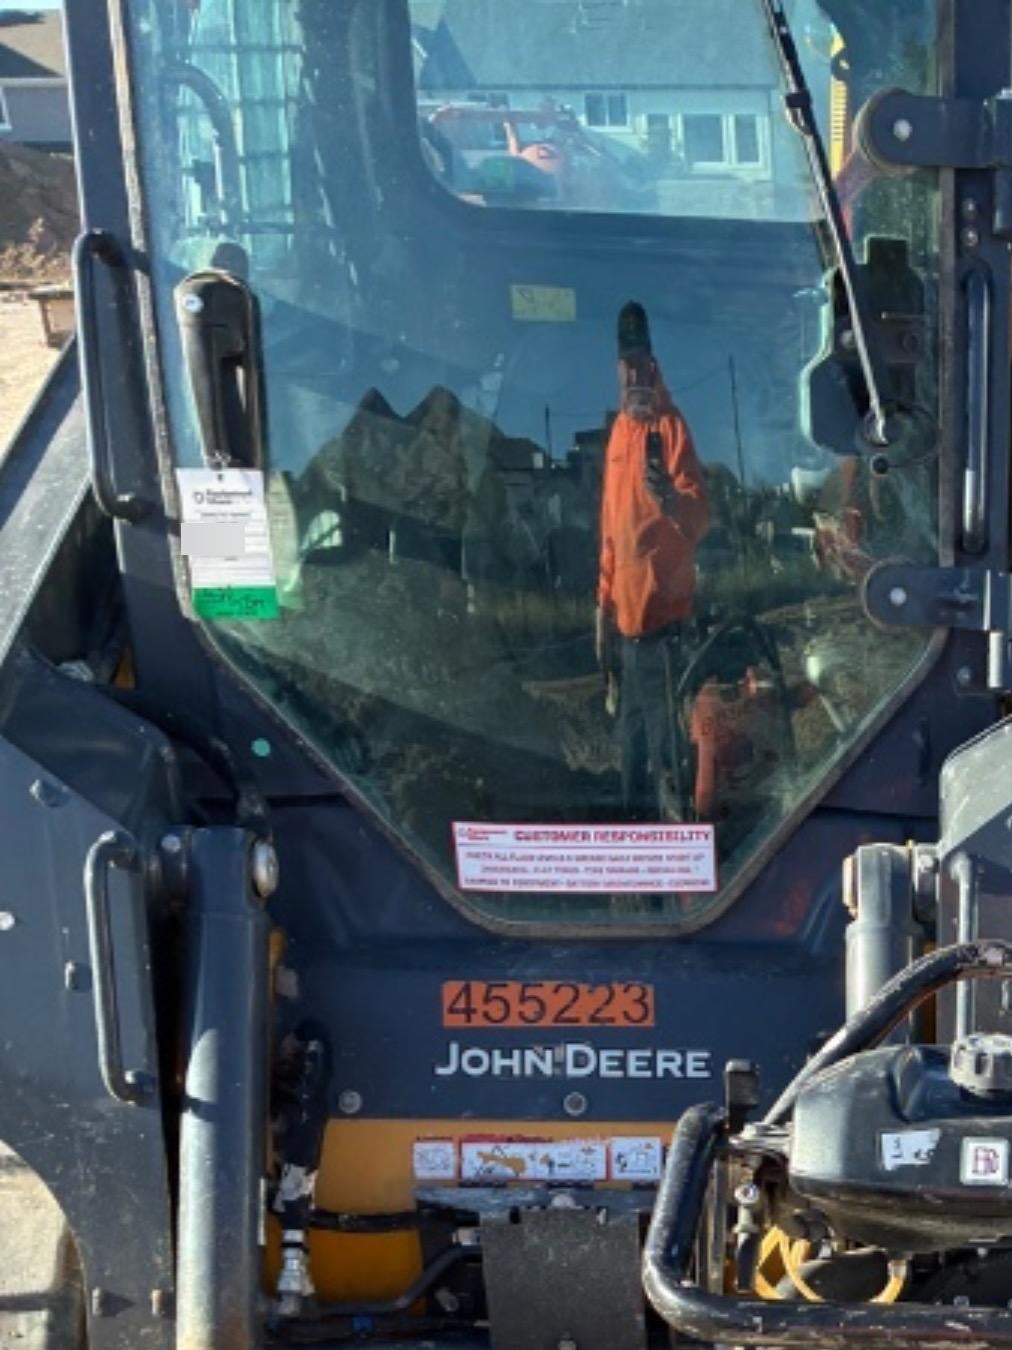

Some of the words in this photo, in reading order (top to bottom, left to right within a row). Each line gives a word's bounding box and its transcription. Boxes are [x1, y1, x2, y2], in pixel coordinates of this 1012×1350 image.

[446, 982, 650, 1025] 455223
[434, 1041, 554, 1078] JOHN
[564, 1042, 712, 1079] DEERE
